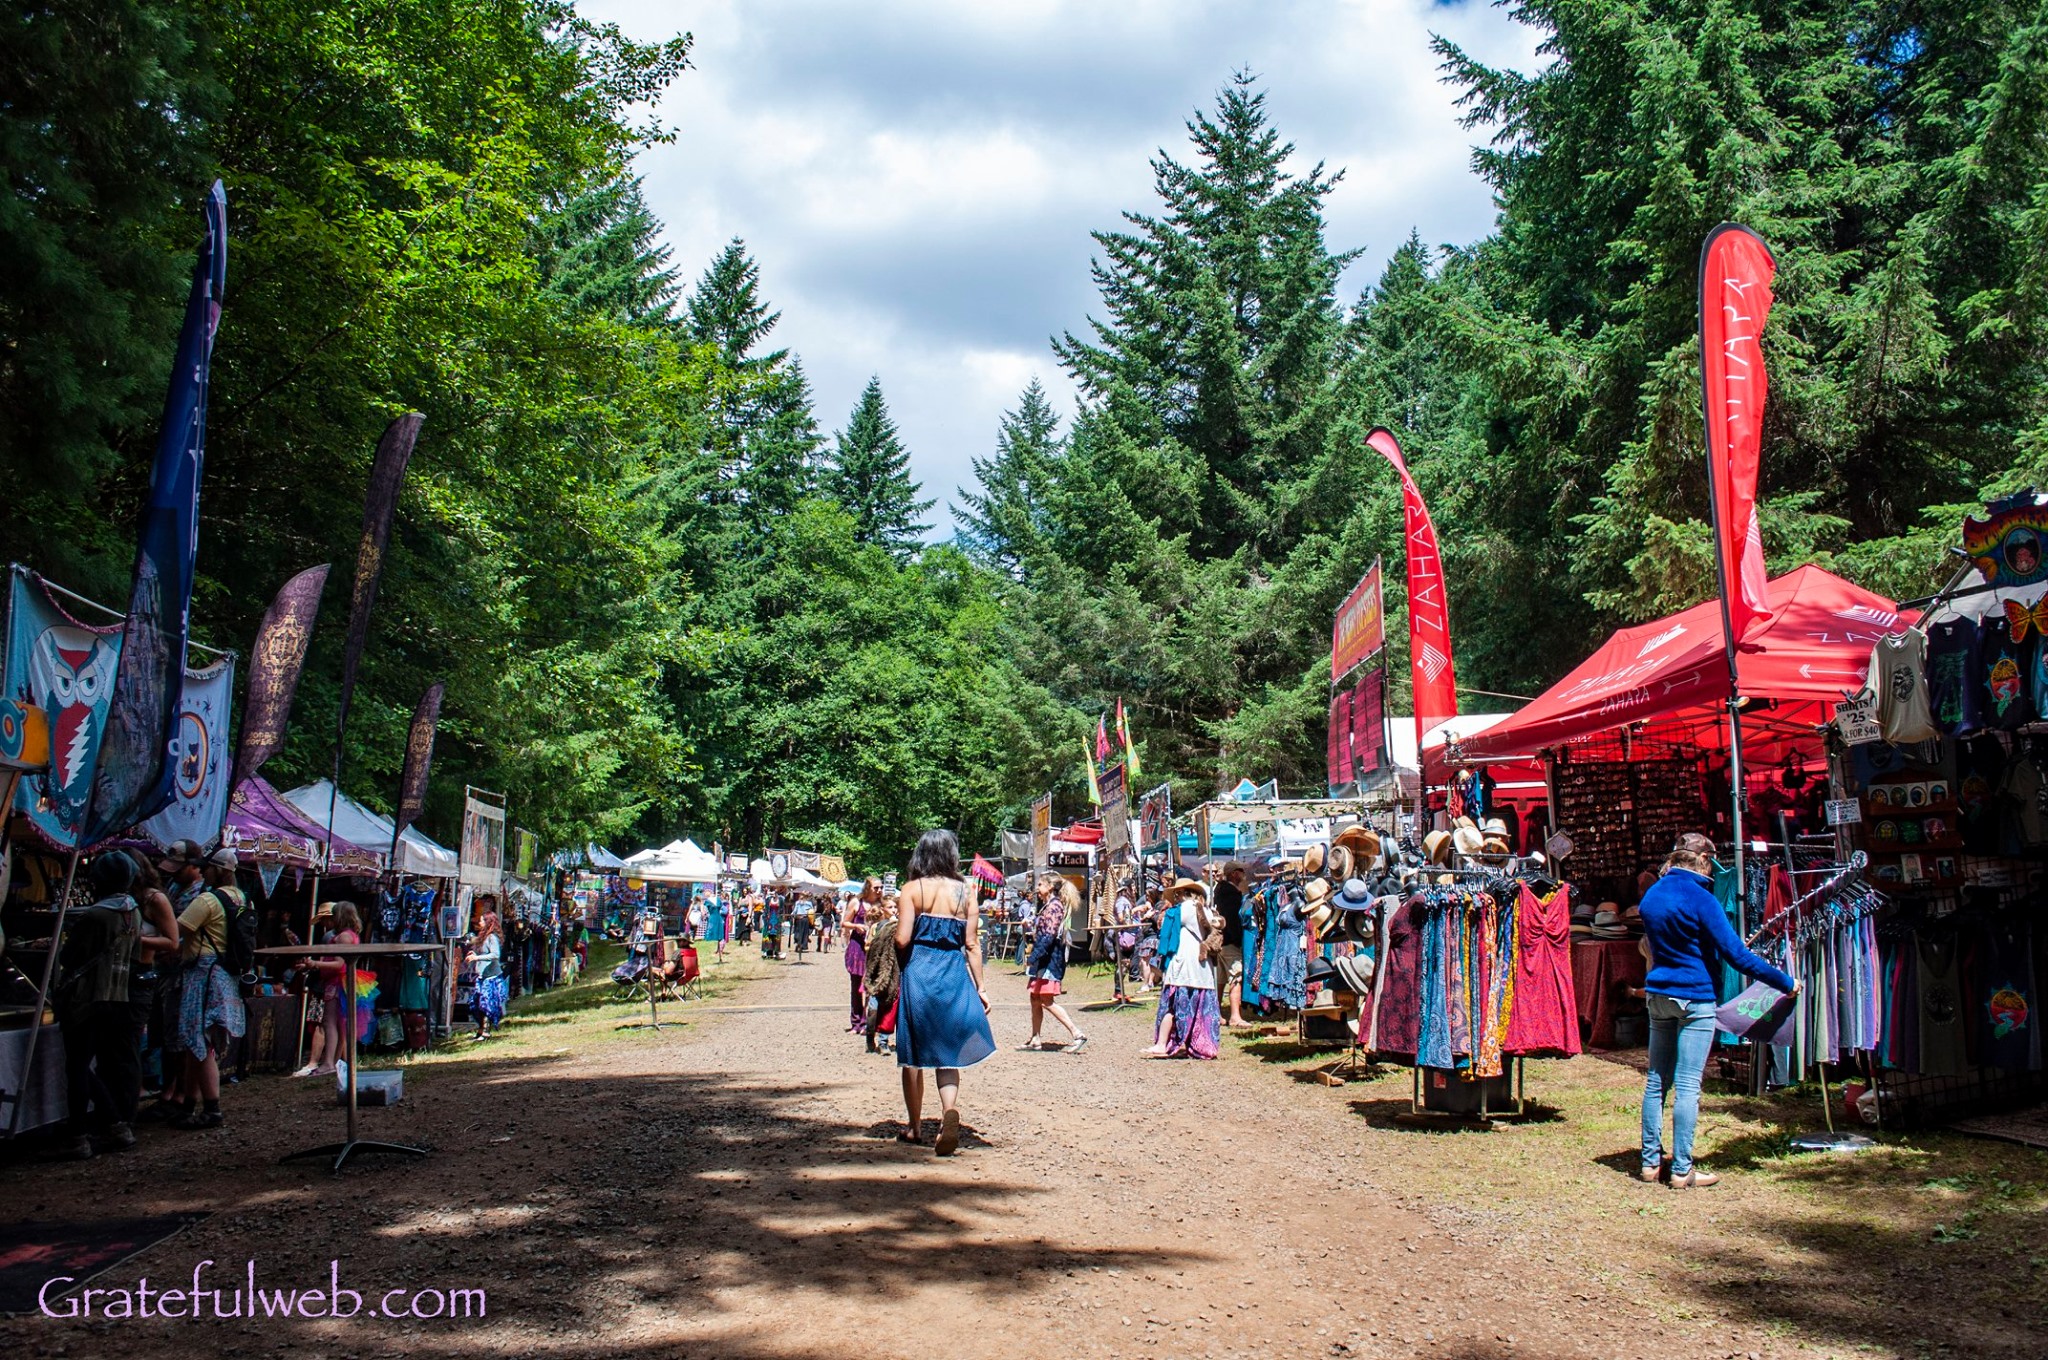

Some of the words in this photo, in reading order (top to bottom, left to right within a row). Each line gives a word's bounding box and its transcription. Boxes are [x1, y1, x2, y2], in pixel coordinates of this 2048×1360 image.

[1403, 480, 1443, 634] ZAHARA
[1599, 685, 1651, 717] ZAHARA
[1864, 725, 1879, 737] $40
[1064, 854, 1086, 866] Each
